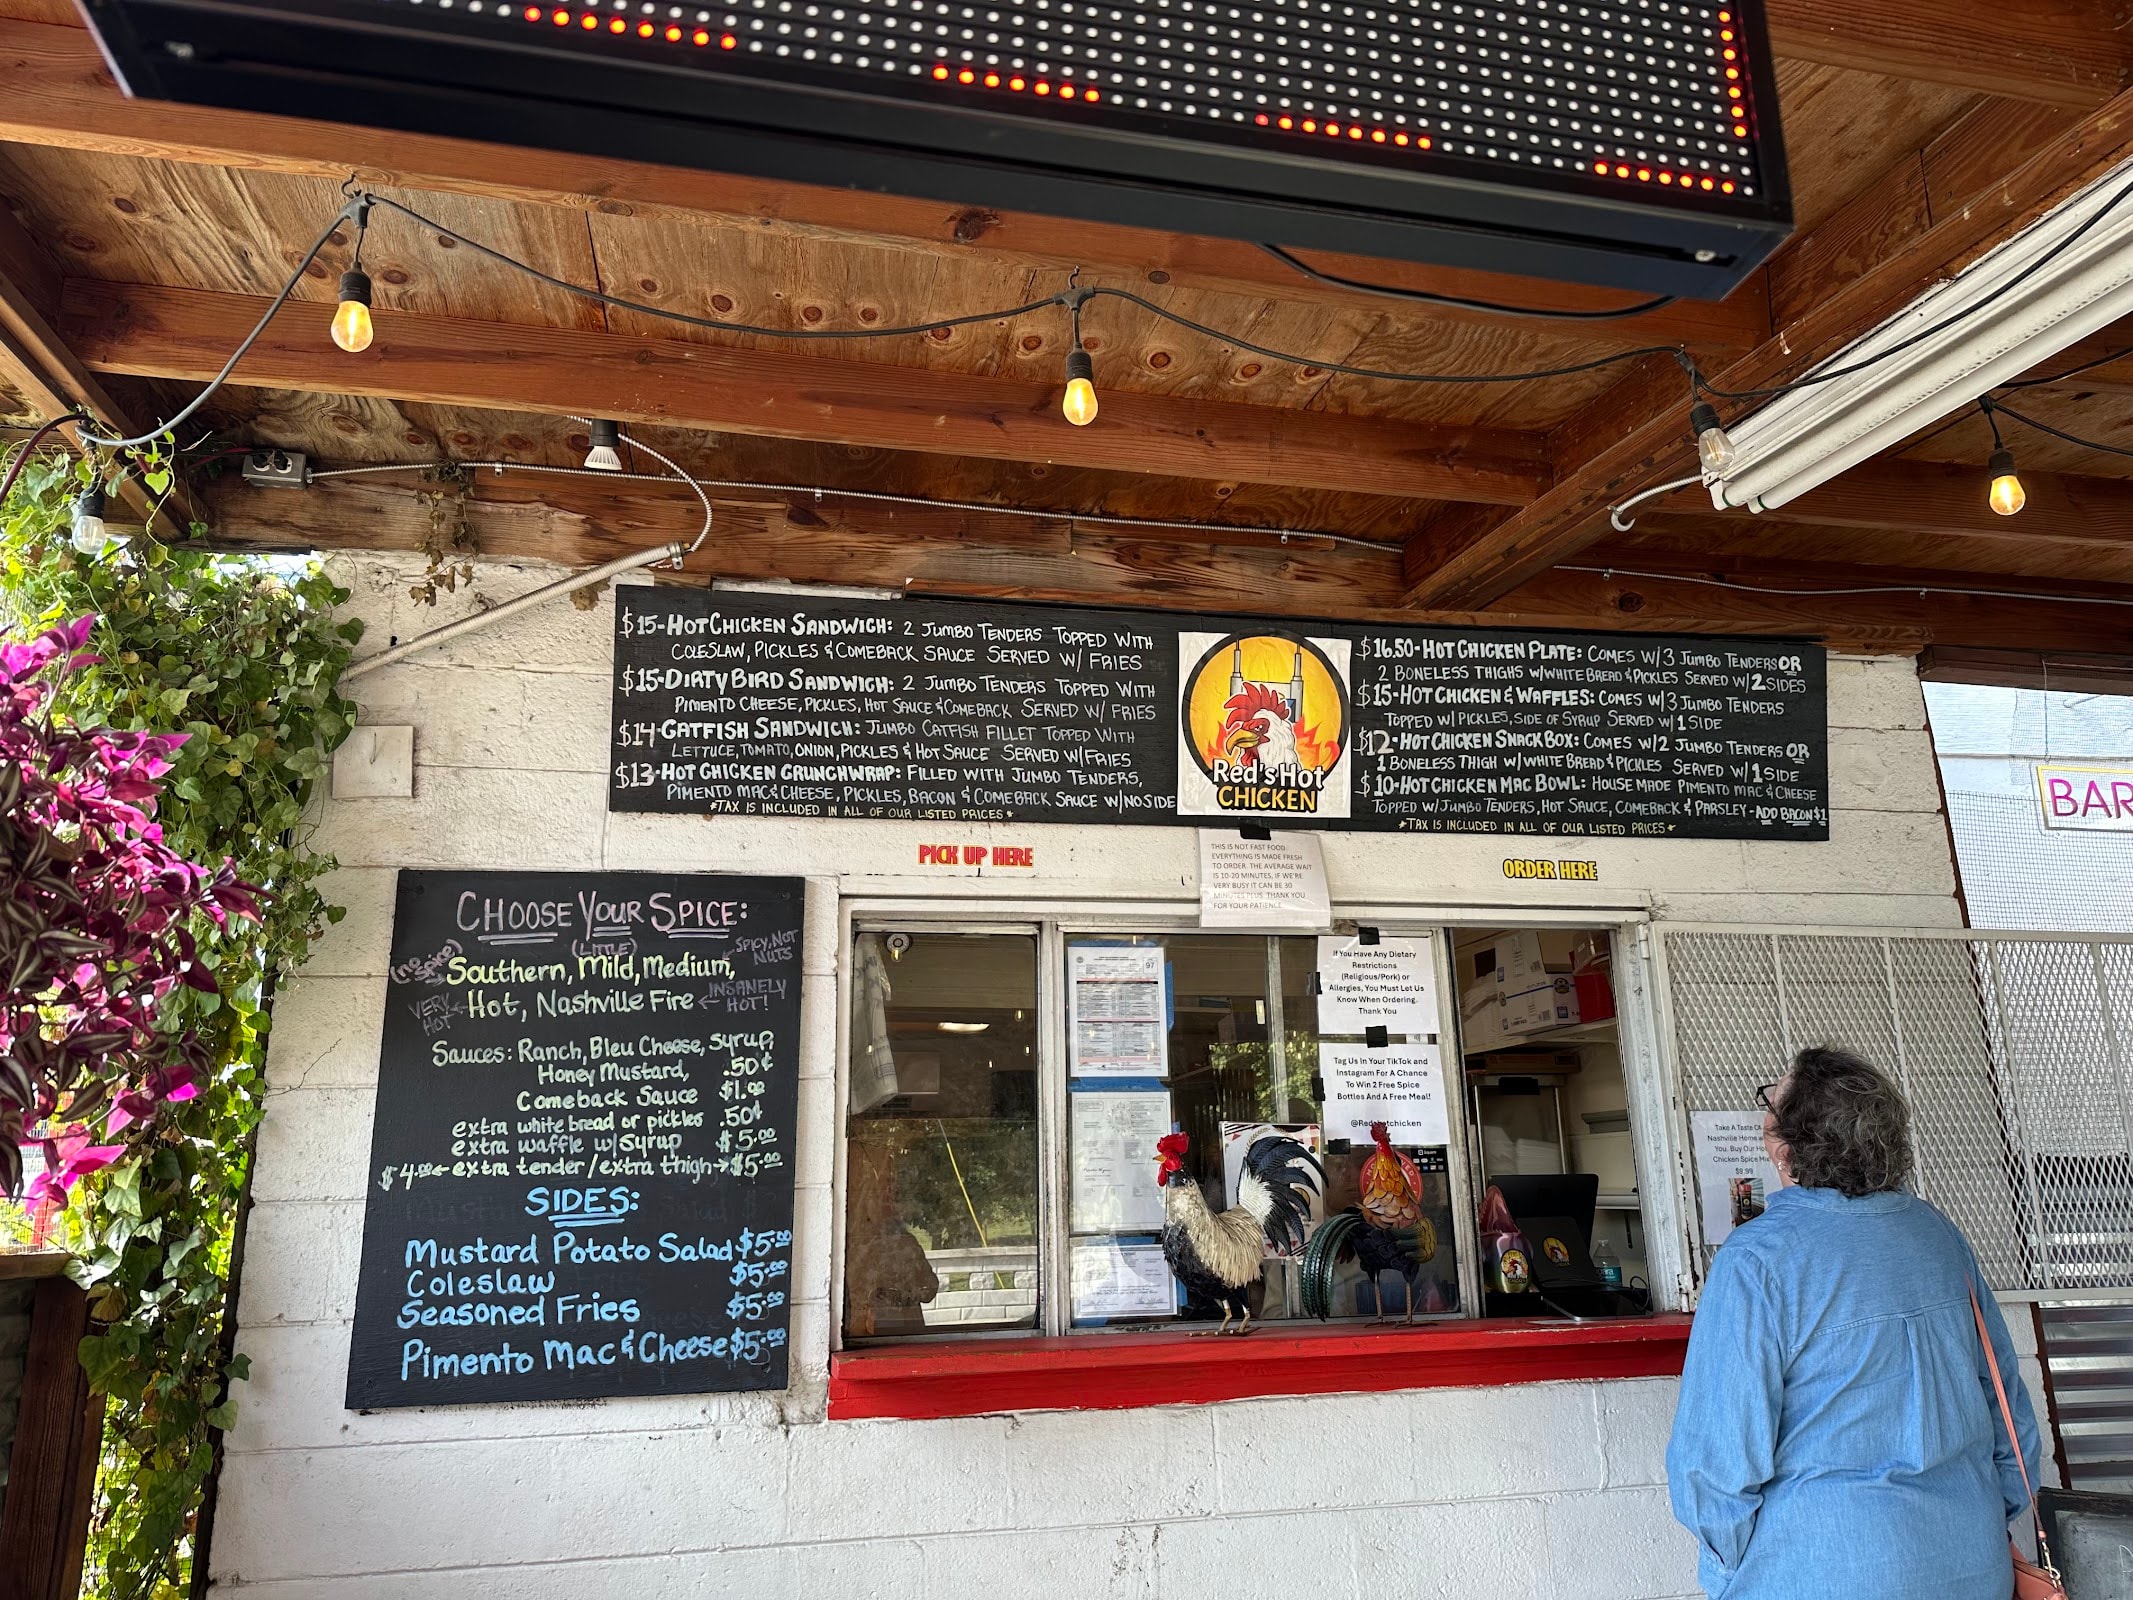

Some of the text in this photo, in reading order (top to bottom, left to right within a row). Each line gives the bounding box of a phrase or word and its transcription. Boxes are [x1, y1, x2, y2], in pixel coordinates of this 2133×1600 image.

[903, 621, 914, 635] 2
[921, 622, 973, 638] JUMBO
[977, 622, 1043, 642] TENDERS
[1052, 626, 1107, 649] TOPPED
[1114, 632, 1153, 650] WITH
[755, 641, 1142, 671] PICKLES SAUCE SERVED FRIES
[1528, 640, 1721, 668] PLATE: COMES JUMBO
[731, 667, 1155, 698] BIRD 2 JUMBO TENDERS TOPPED WITH
[1395, 665, 1728, 686] BONELESS THIGHS SERVED
[675, 696, 1156, 720] PIMENTO CHEESE, PICKLES, HOT SAUCE SERVED FRIES
[1515, 687, 1785, 715] WAFFLES: COMES JUMBO TENDERS
[865, 719, 1135, 743] JUMBO CATFISH FILLET TOPPED WITH
[1384, 710, 1654, 729] TOPPED OF SYRUP SERVED
[1000, 744, 1059, 763] SERVED
[1495, 730, 1783, 758] SNACK COMES JUMBO TENDERS
[907, 765, 1143, 787] FILLED WITH JUMBO TENDERS,
[1279, 763, 1325, 790] Hot
[1389, 755, 1724, 778] BONELESS THIGH SERVED
[666, 784, 1098, 808] PIMENTO PICKLES, SAUCE
[1500, 774, 1763, 798] MAC BOWL: HOUSE MADE PIMENTO MAC
[1218, 785, 1316, 812] CHICKEN
[1371, 798, 1681, 817] TOPPED SAUCE, COMEBACK
[762, 802, 957, 820] INCLUDED ALL OF OUR LISTED
[1446, 819, 1626, 835] INCLUDED ALL OUR LISTED
[919, 844, 1033, 866] PICK UP HERE
[1503, 859, 1598, 881] ORDER HERE
[456, 890, 749, 941] CHOOSE YOUR SPICE:
[753, 947, 793, 965] NUTS
[1389, 951, 1417, 959] Dietary
[446, 951, 735, 987] Southern, Mild, Medium,
[1341, 973, 1400, 981] (Religious/Pork)
[709, 979, 786, 999] INSANELY
[1329, 984, 1364, 993] Allergies,
[467, 988, 694, 1022] Hot, Nashville Fire
[1358, 1007, 1381, 1015] Thank
[431, 1036, 634, 1067] Sauces: Ranch, Bleu
[537, 1060, 690, 1087] Honey Mustard,
[1336, 1069, 1375, 1077] Instagram
[1397, 1081, 1420, 1089] Spice
[516, 1087, 698, 1111] Comeback Sauce
[451, 1108, 704, 1138] extra or pickles
[451, 1135, 585, 1157] extra waffle
[451, 1151, 715, 1181] extra tender thigh
[1740, 1156, 1758, 1164] Spice
[524, 1186, 640, 1216] SIDES:
[404, 1233, 538, 1267] Mustard
[553, 1231, 651, 1265] Potato
[658, 1232, 733, 1262] Salad
[406, 1268, 556, 1298] Coleslaw
[396, 1295, 545, 1329] Seasoned
[556, 1292, 641, 1324] Fries
[400, 1338, 533, 1382] Pimento
[543, 1340, 616, 1370] Mac
